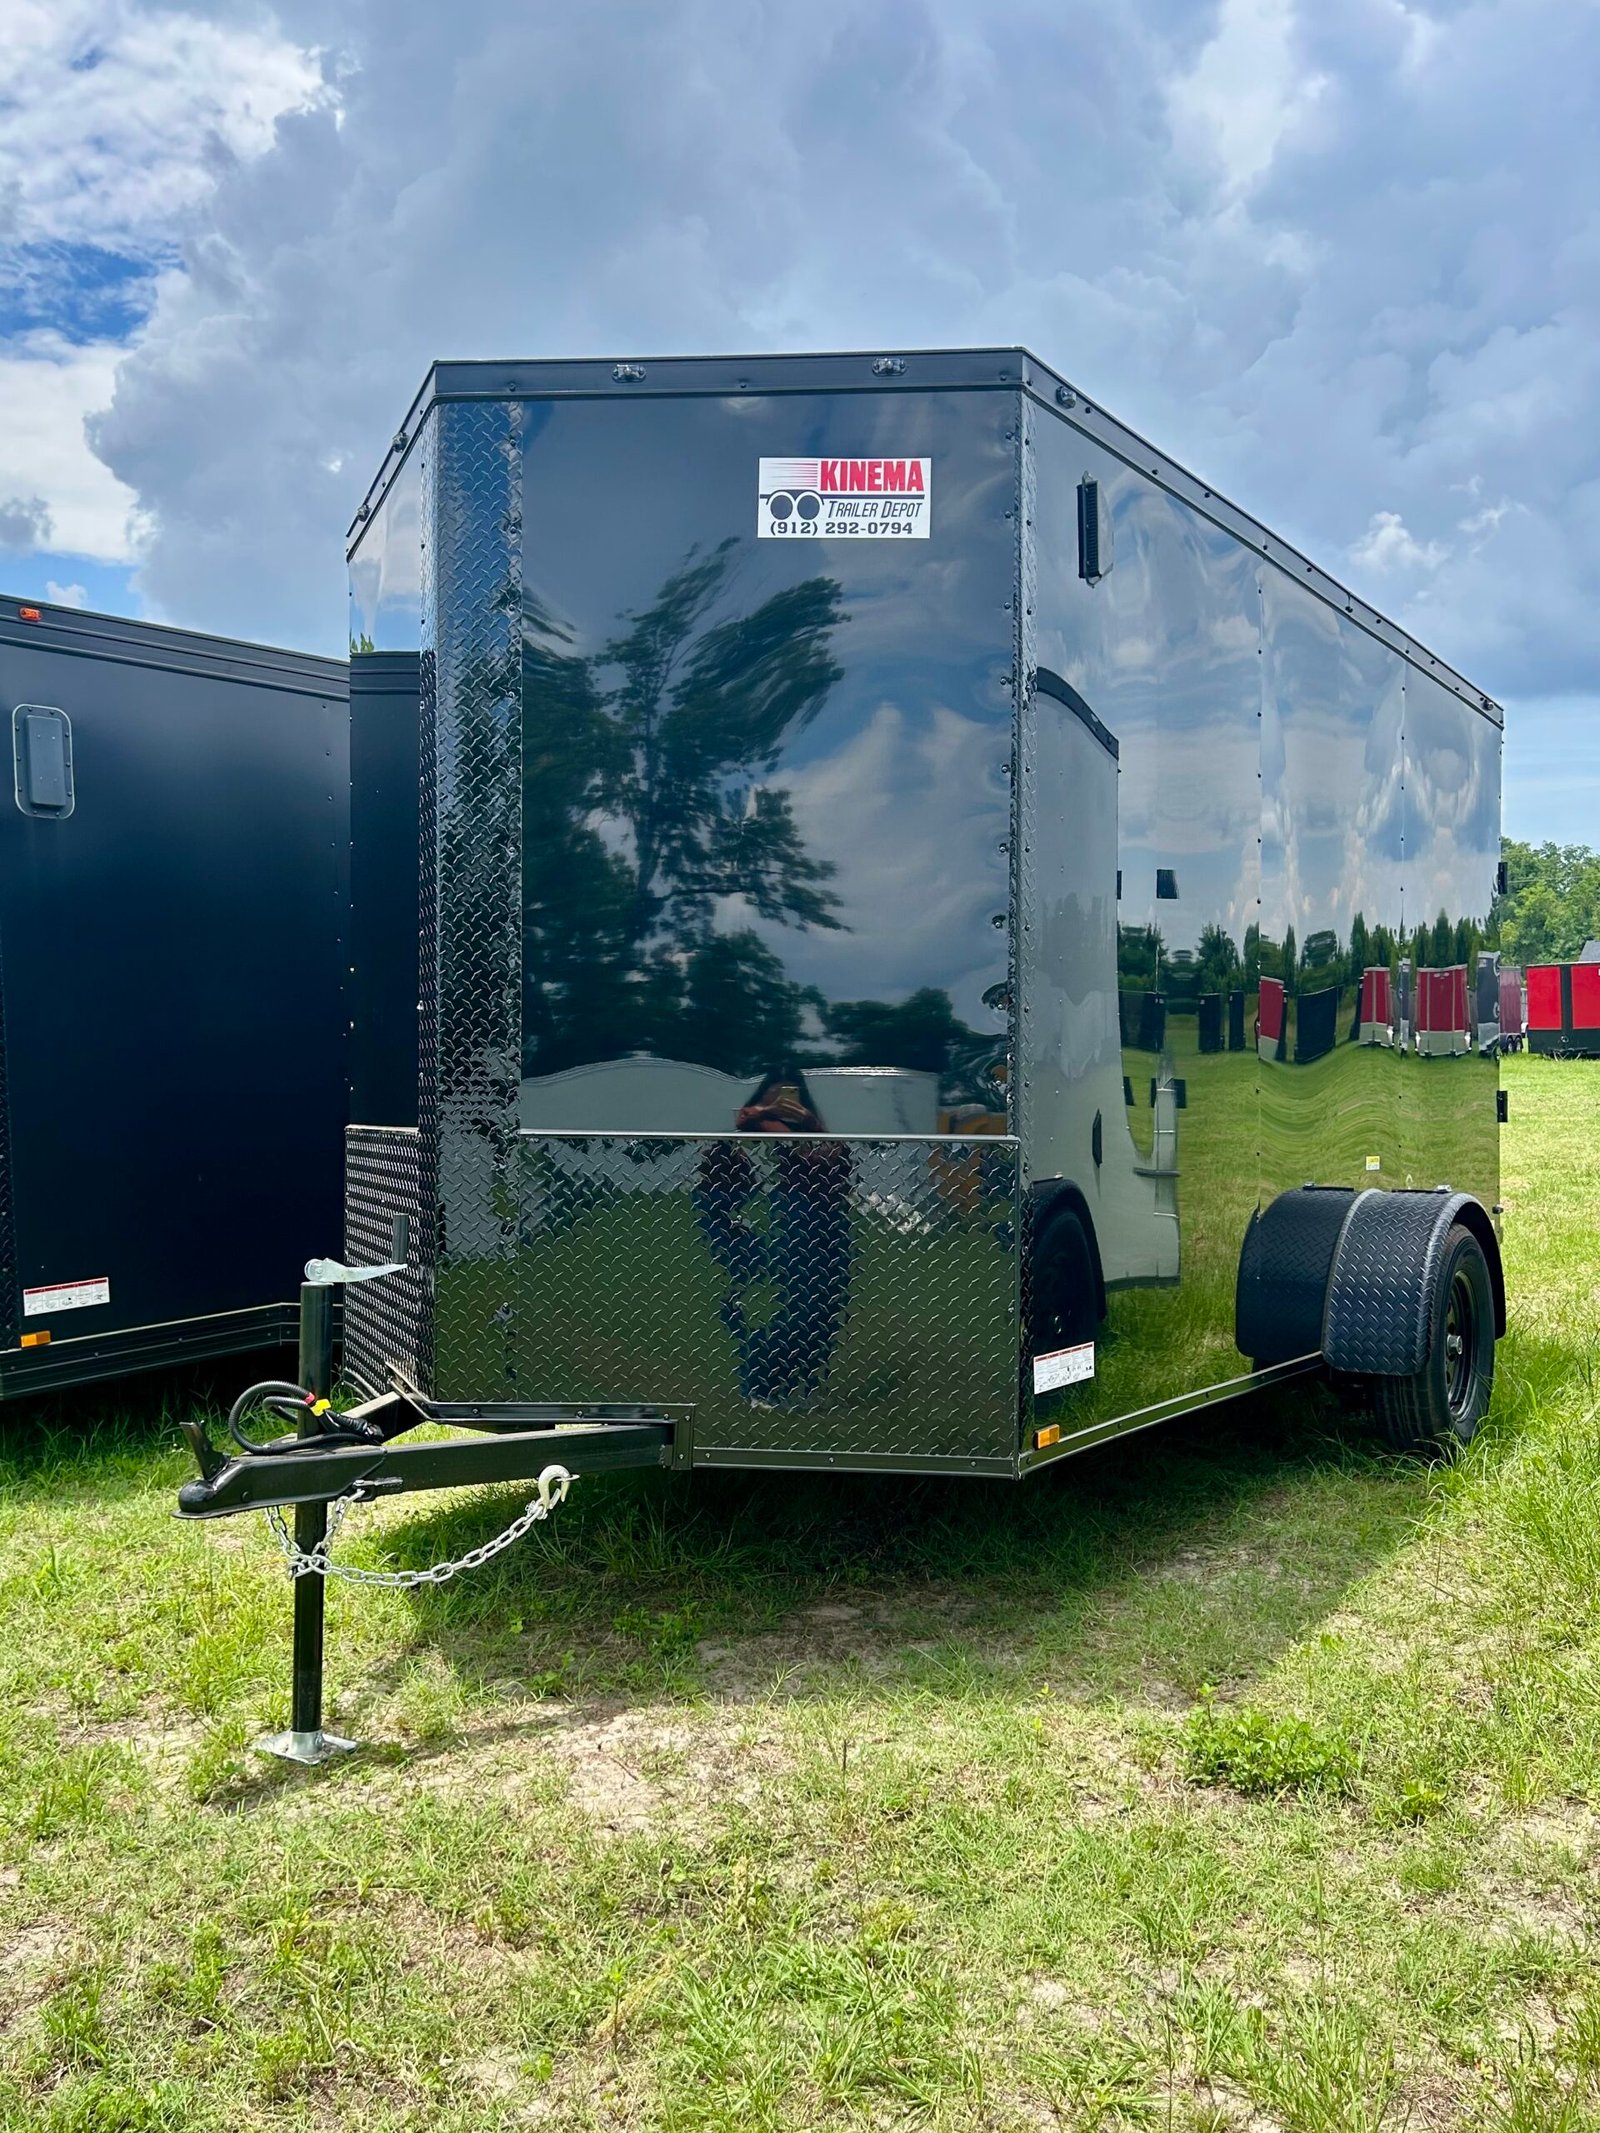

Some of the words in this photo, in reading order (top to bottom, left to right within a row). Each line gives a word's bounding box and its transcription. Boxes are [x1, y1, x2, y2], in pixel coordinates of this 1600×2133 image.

[820, 461, 924, 491] KINEMA
[770, 521, 818, 535] (912)
[825, 522, 913, 535] 292-0794
